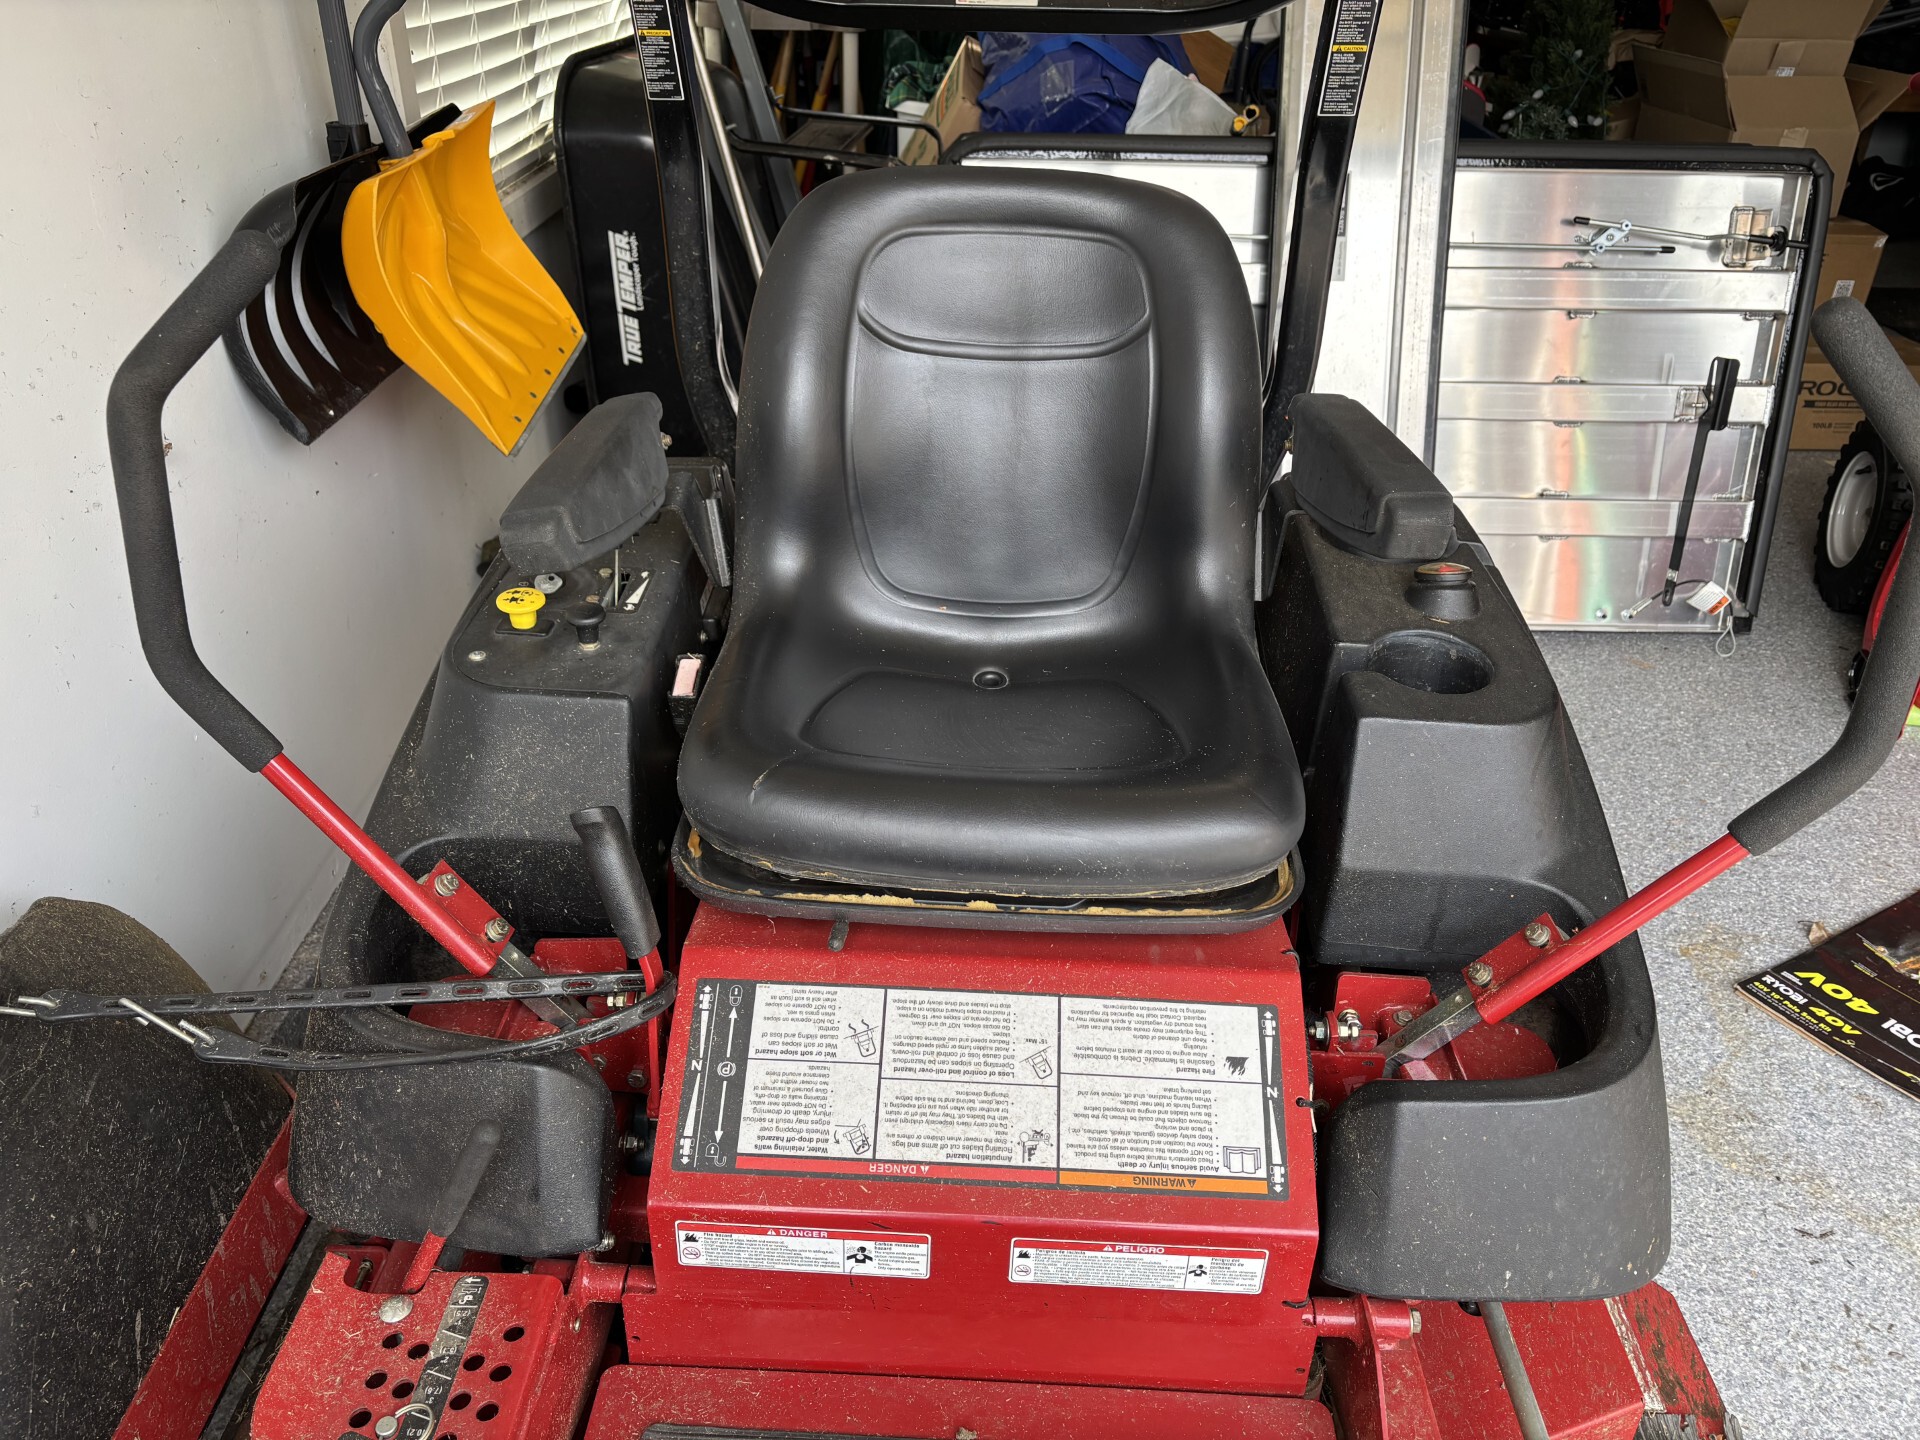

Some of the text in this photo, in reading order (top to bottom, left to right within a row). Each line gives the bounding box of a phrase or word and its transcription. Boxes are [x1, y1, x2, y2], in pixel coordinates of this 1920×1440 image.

[632, 262, 644, 311] Landscaper
[608, 230, 643, 366] TRUE TEMPER
[1793, 971, 1880, 1015] 40V
[1753, 981, 1772, 993] 40V
[1782, 1000, 1801, 1013] Pole
[1800, 1012, 1819, 1024] Saw
[1818, 1022, 1832, 1033] Kit
[1761, 974, 1809, 1005] RYOBI
[1808, 1006, 1862, 1035] 40V
[691, 1060, 703, 1071] N
[982, 1061, 1014, 1069] Operating
[1267, 1087, 1278, 1098] N
[984, 1145, 1012, 1153] Rotating
[971, 1153, 1012, 1161] Amputation
[869, 1163, 917, 1174] DANGER
[1133, 1176, 1186, 1188] WARNING
[780, 1229, 828, 1238] DANGER
[1115, 1245, 1165, 1254] PELIGRO
